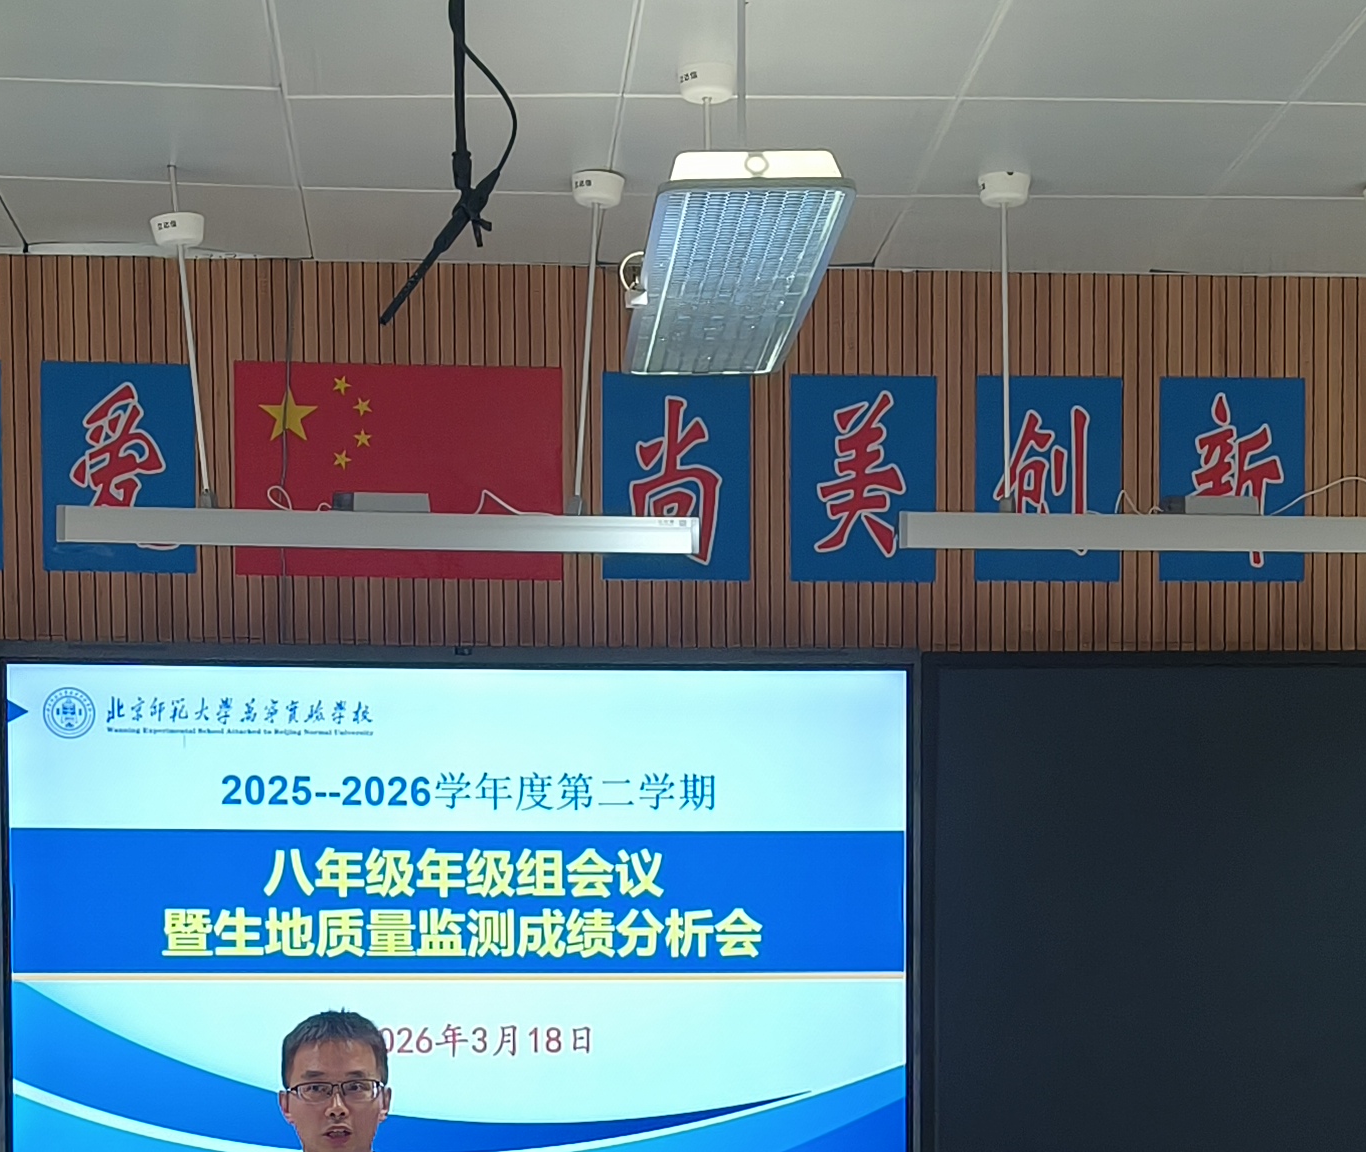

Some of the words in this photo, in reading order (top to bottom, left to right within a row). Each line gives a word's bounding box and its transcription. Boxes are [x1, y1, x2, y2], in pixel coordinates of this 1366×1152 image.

[221, 772, 717, 813] 2025--2026学年度第二学期
[264, 848, 664, 899] 八年级年级组会议
[162, 906, 763, 959] 暨生地质量监测成绩分析会
[378, 1023, 592, 1058] 026年3月18日
